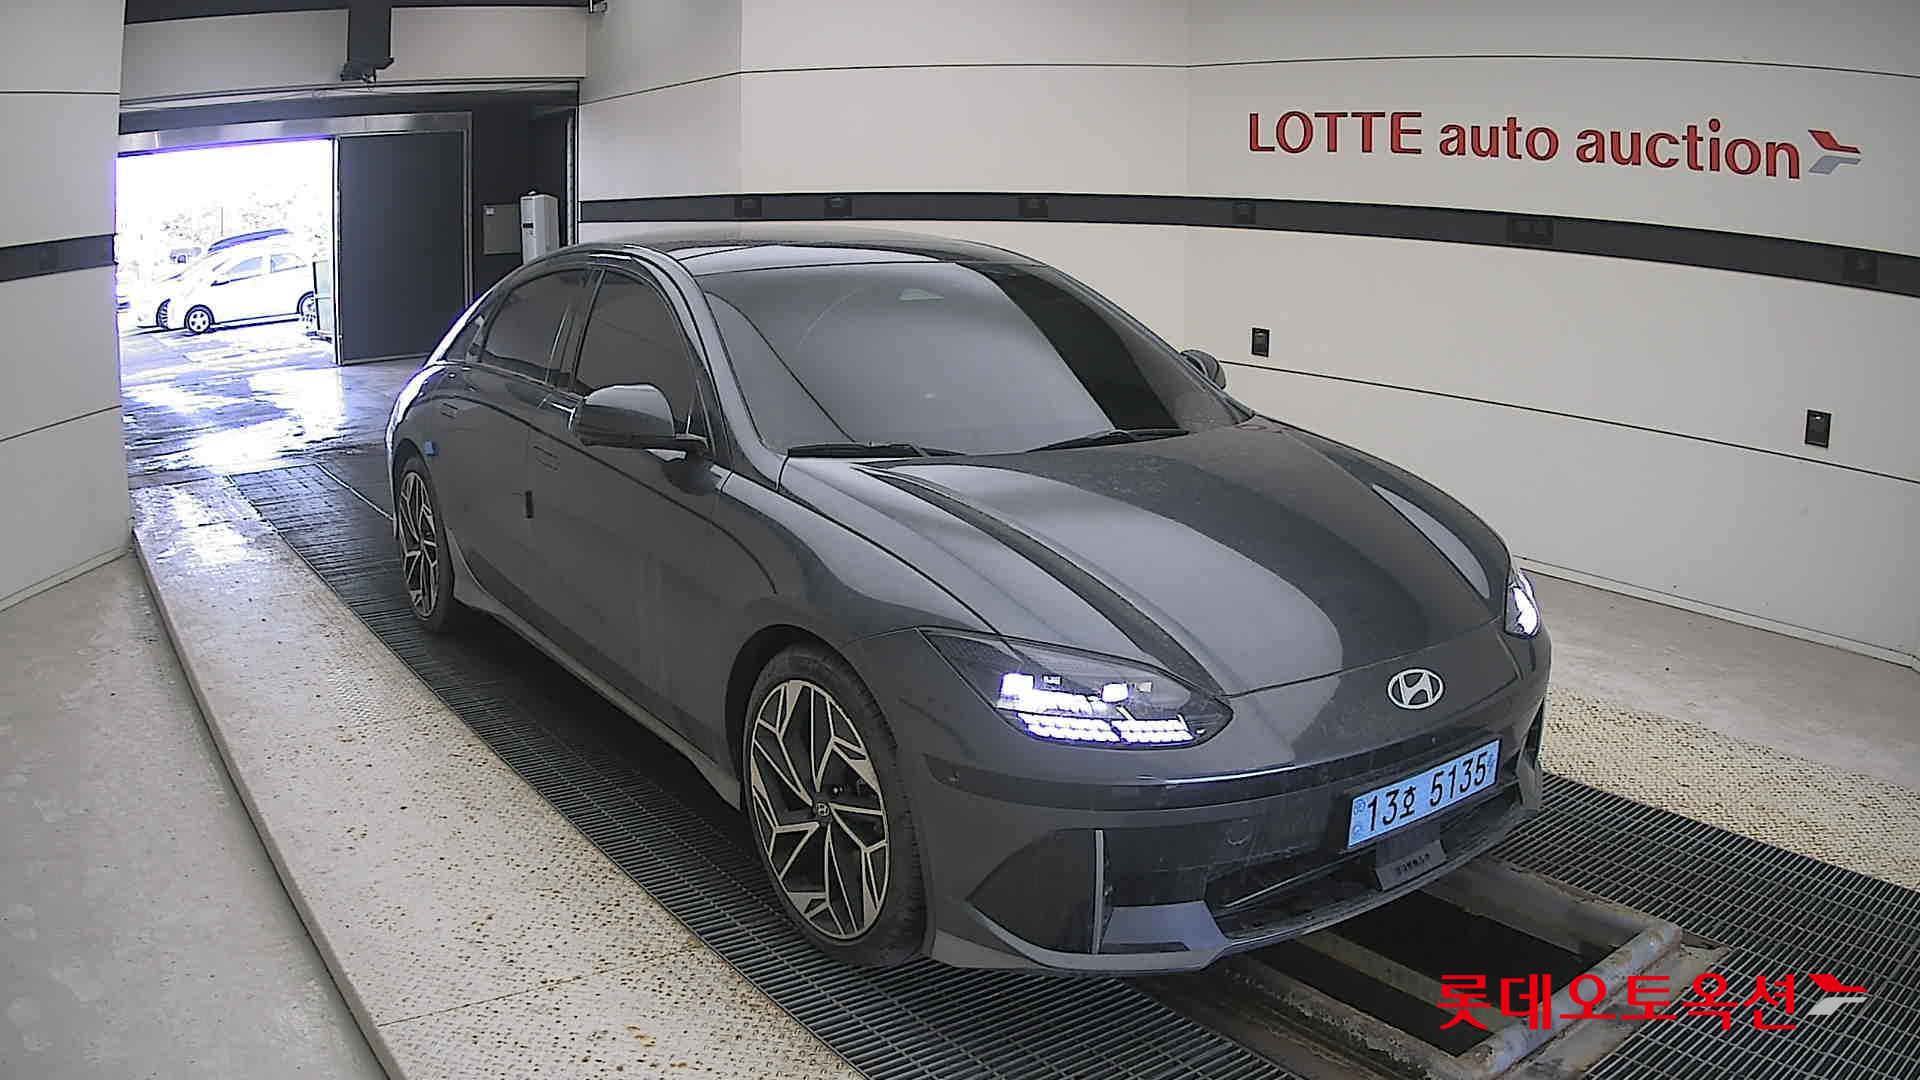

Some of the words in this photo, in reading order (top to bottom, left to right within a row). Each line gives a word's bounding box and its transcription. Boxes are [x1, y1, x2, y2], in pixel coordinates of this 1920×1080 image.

[1248, 111, 1425, 157] LOTTE
[1438, 116, 1560, 162] auto
[1575, 118, 1802, 181] auction
[1367, 786, 1417, 833] 13호
[1429, 751, 1489, 808] 5135
